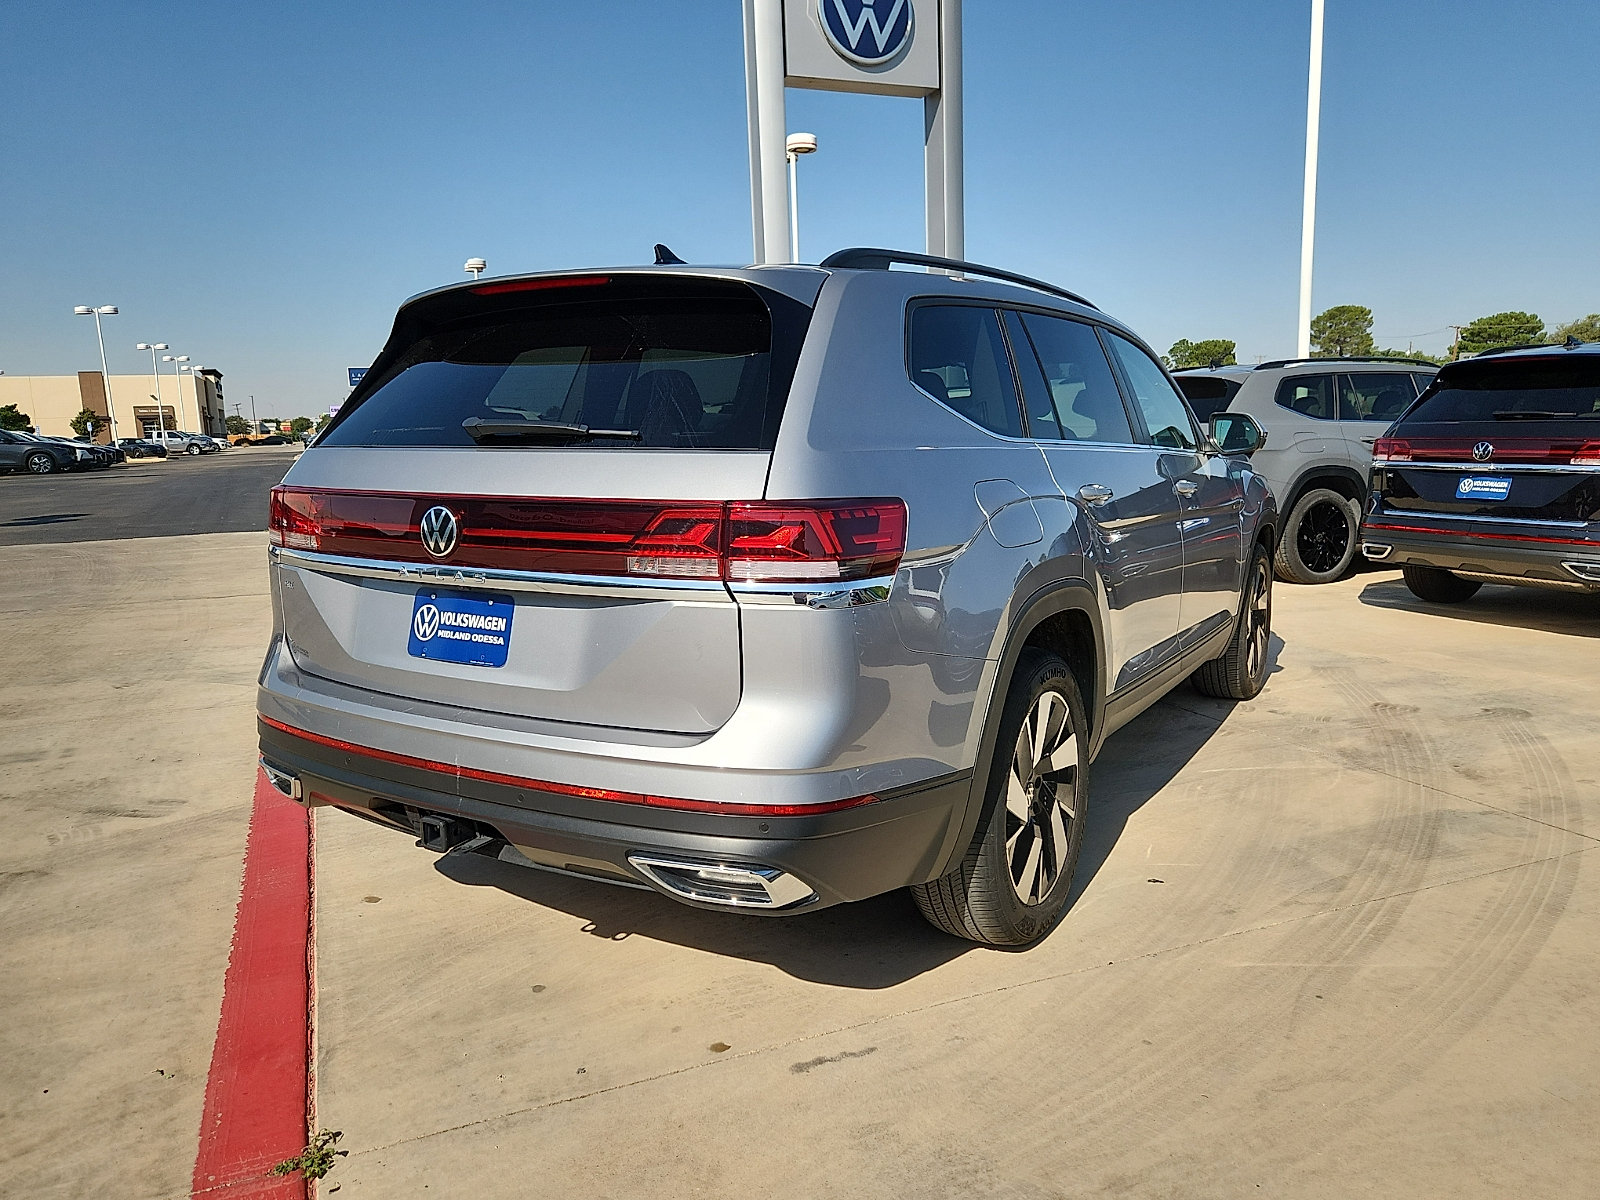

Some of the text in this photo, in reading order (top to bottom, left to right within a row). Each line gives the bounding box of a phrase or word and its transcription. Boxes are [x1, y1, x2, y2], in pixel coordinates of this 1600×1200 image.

[398, 565, 486, 584] ATLAS
[440, 611, 507, 632] VOLKSWAGEN
[438, 630, 504, 645] MIDLAND ODESSA
[1039, 667, 1066, 685] KUMHO
